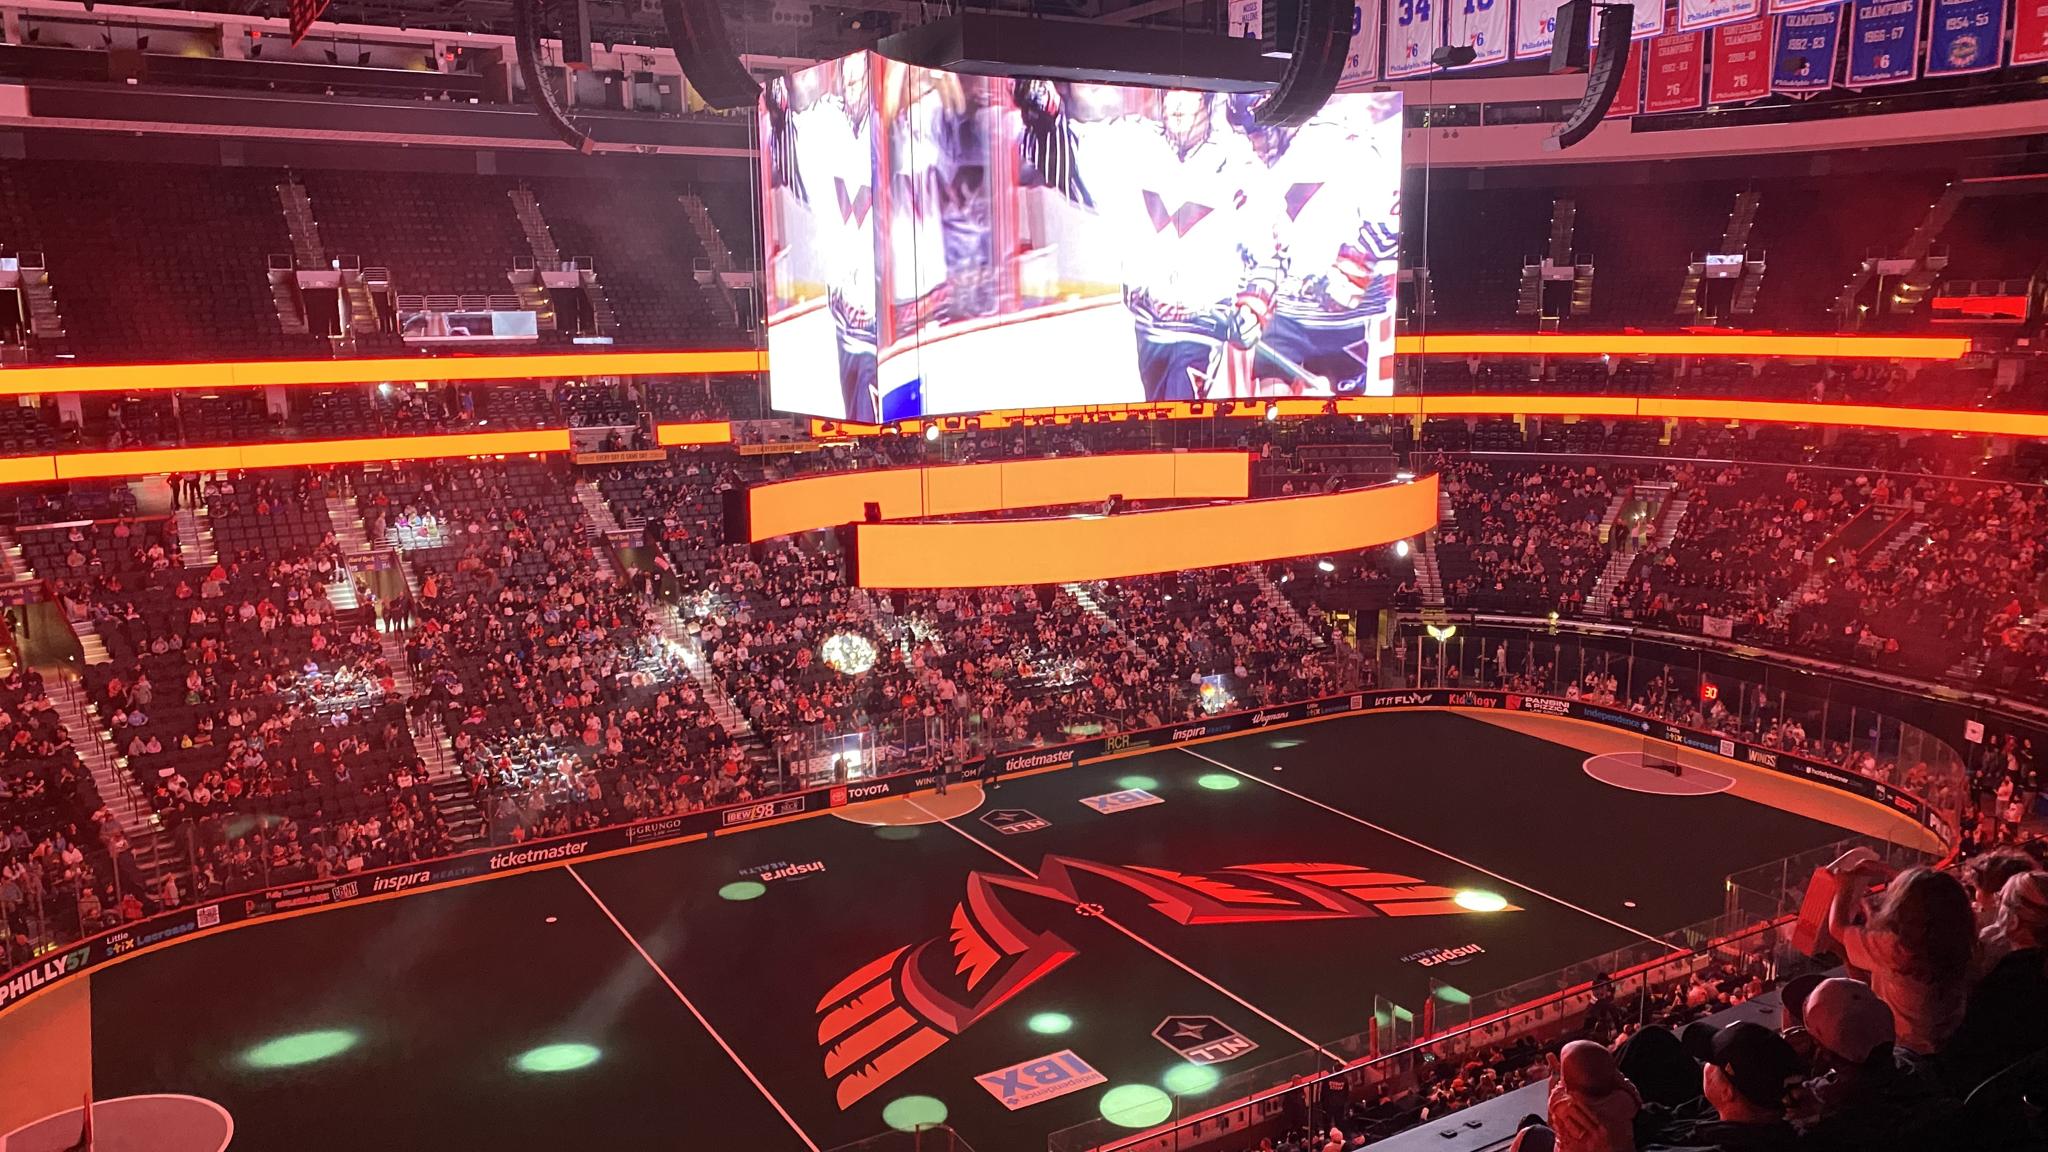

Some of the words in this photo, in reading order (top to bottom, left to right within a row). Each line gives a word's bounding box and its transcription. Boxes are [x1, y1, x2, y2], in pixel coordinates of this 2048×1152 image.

[1399, 0, 1431, 26] 34
[1860, 1, 1913, 19] CHAMPIONS
[1539, 17, 1556, 34] 76
[1785, 12, 1834, 27] CHAMPIONS
[1705, 686, 1718, 699] 30
[1584, 707, 1640, 728] Independence
[1107, 734, 1130, 750] RCR
[1172, 726, 1206, 741] inspira
[1006, 749, 1075, 772] ticketmaster
[1748, 749, 1777, 767] WINGS
[848, 783, 890, 798] TOYOTA
[636, 819, 682, 836] GRUNGO
[373, 869, 431, 891] inspira
[489, 840, 589, 870] ticketmaster
[761, 860, 827, 881] inspira
[106, 932, 129, 945] Little
[1417, 943, 1486, 967] inspira
[1188, 1037, 1250, 1060] NLL
[981, 1053, 1093, 1099] IBX
